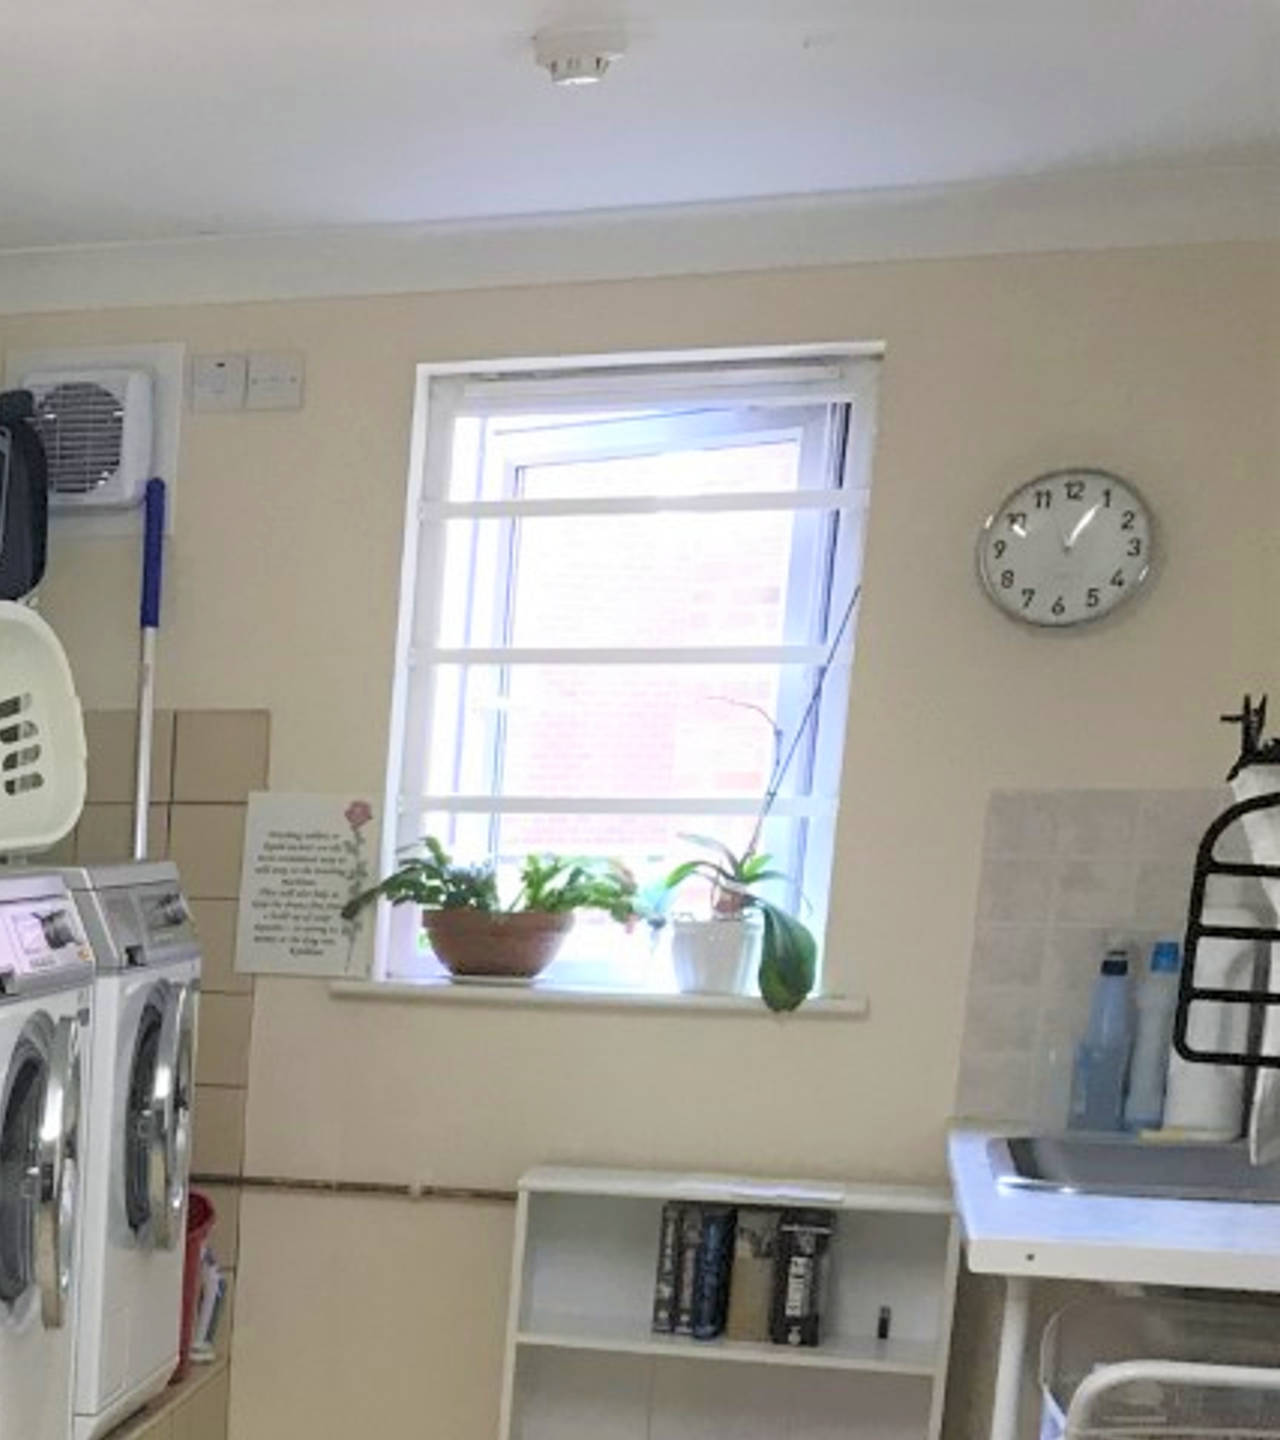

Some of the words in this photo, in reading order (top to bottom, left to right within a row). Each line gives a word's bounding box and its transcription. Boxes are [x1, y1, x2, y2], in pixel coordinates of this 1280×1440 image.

[1034, 491, 1052, 509] 11
[1065, 480, 1086, 501] 12
[1101, 488, 1112, 508] 1
[1120, 510, 1136, 530] 2
[993, 540, 1007, 559] 9
[1127, 539, 1142, 557] 3
[1001, 570, 1014, 589] 8
[1109, 568, 1125, 588] 4
[1021, 588, 1036, 608] 7
[1051, 595, 1066, 616] 6
[1085, 588, 1100, 608] 5
